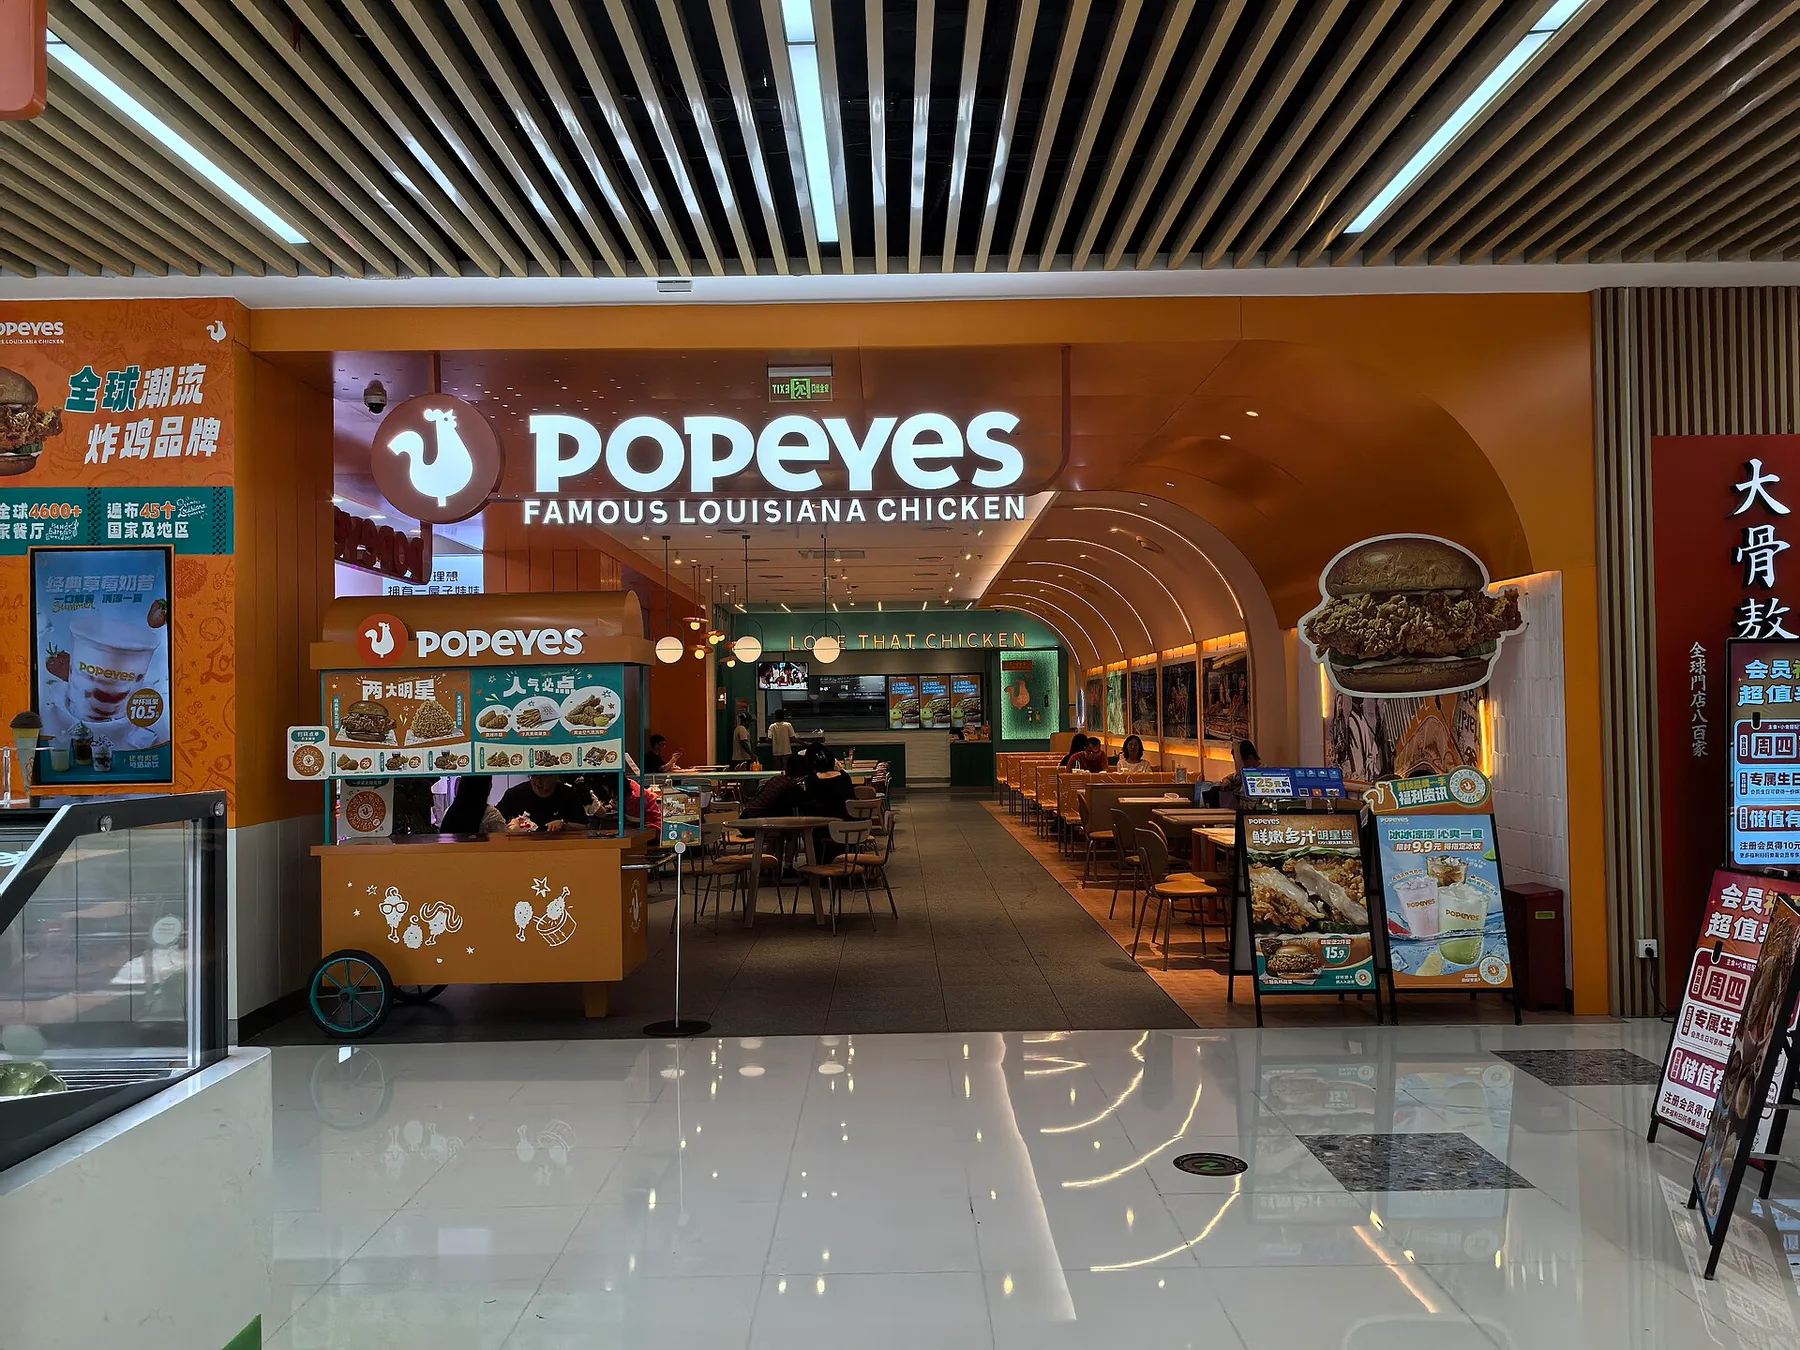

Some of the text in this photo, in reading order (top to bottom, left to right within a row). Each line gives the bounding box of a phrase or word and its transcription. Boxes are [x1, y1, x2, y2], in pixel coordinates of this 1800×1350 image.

[64, 363, 206, 413] 全球潮流
[84, 416, 221, 464] 炸鸡品牌
[529, 412, 1025, 494] POPEYES
[0, 502, 82, 519] 全球4600+
[523, 495, 1026, 526] FAMOUS LOUISIANA CHICKEN
[0, 522, 45, 539] 家餐厅
[107, 521, 189, 539] 国家及地区
[429, 570, 459, 582] 理想
[416, 628, 584, 658] POPEYES
[790, 632, 1026, 650] LOE THAT CHICKEN
[79, 660, 136, 681] POPEYES
[362, 679, 436, 701] 两大明星
[503, 676, 576, 697] 人气必点
[1689, 641, 1708, 757] 全球門店八百家
[1754, 737, 1793, 757] 周四
[1399, 786, 1449, 806] 福利资讯
[1252, 827, 1353, 846] 鲜嫩多汁 明星堡
[1445, 909, 1480, 921] POPEYES
[1704, 971, 1747, 1006] 周四
[1695, 1009, 1737, 1039] 专属生
